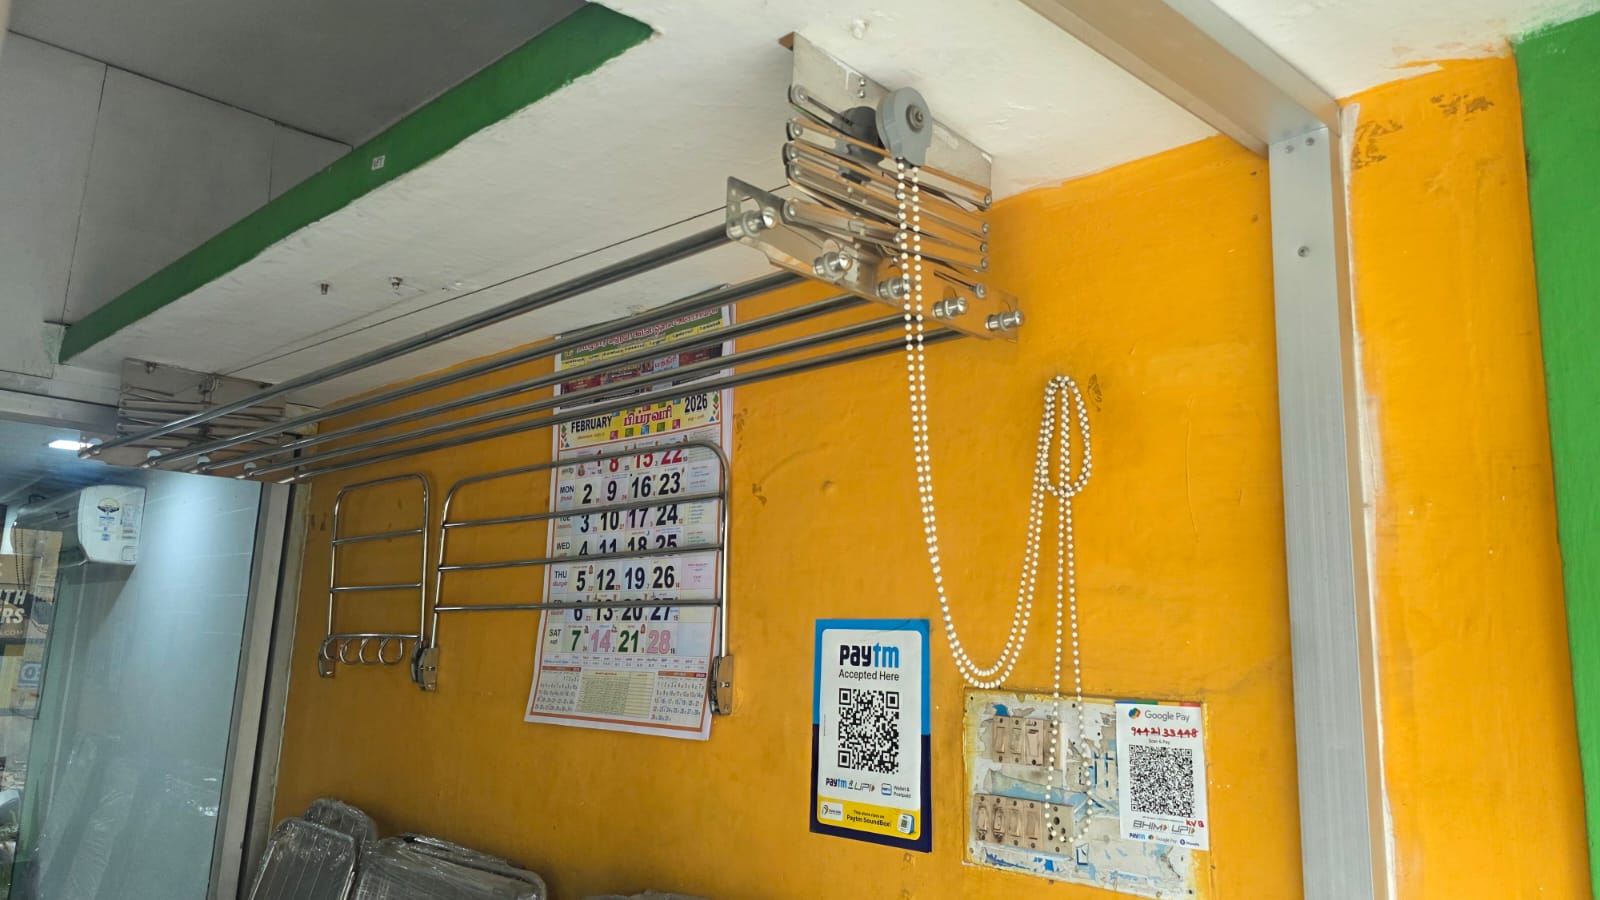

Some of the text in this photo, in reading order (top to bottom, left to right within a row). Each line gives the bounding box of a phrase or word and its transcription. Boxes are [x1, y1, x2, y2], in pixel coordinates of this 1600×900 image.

[685, 393, 708, 414] 2026
[571, 416, 613, 433] FEBRUARY
[624, 405, 673, 427] பிப்ரவரி
[559, 484, 575, 494] MON
[582, 483, 593, 505] 2
[607, 480, 618, 501] 9
[632, 475, 652, 498] 16
[658, 471, 681, 496] 23
[580, 513, 590, 533] 3
[601, 511, 620, 531] 10
[629, 508, 648, 528] 17
[656, 503, 678, 527] 24
[556, 541, 571, 550] WED
[579, 540, 588, 556] 4
[599, 538, 617, 554] 11
[627, 536, 648, 552] 18
[655, 533, 677, 549] 25
[554, 570, 568, 579] THU
[576, 570, 587, 592] 5
[596, 568, 616, 591] 12
[625, 566, 646, 590] 19
[652, 565, 675, 589] 26
[621, 598, 643, 621] 20
[650, 597, 674, 621] 27
[548, 629, 671, 655] SAT 7 14 21 28
[838, 669, 900, 682] Accepted Here
[1145, 710, 1190, 723] Google Pay
[1133, 820, 1162, 832] BHIM
